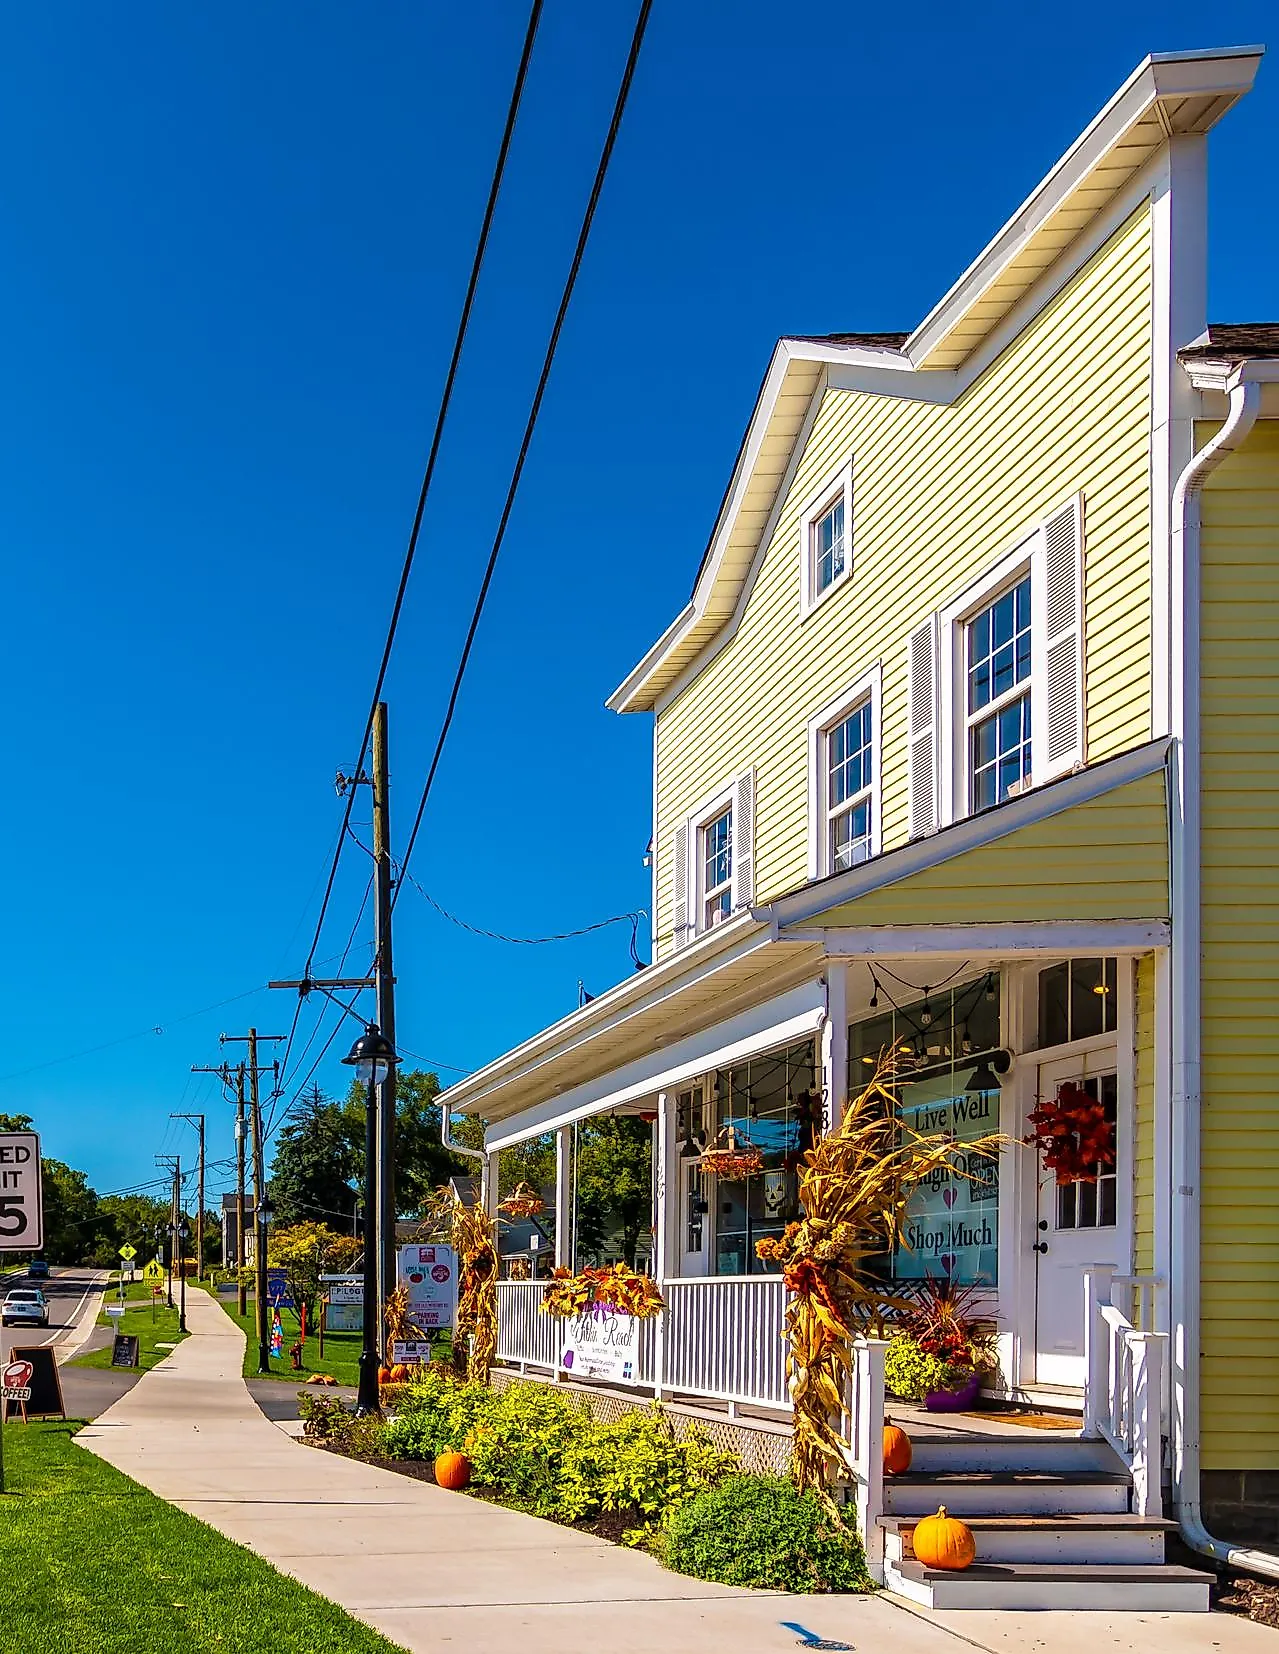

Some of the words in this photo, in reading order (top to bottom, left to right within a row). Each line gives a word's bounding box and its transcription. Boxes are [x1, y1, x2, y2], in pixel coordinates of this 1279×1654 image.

[914, 1107, 947, 1131] Live
[952, 1092, 990, 1124] Well
[971, 1165, 999, 1189] OPEN
[908, 1223, 945, 1256] Shop
[948, 1218, 992, 1248] Much
[1, 1387, 30, 1399] OFFEE!
